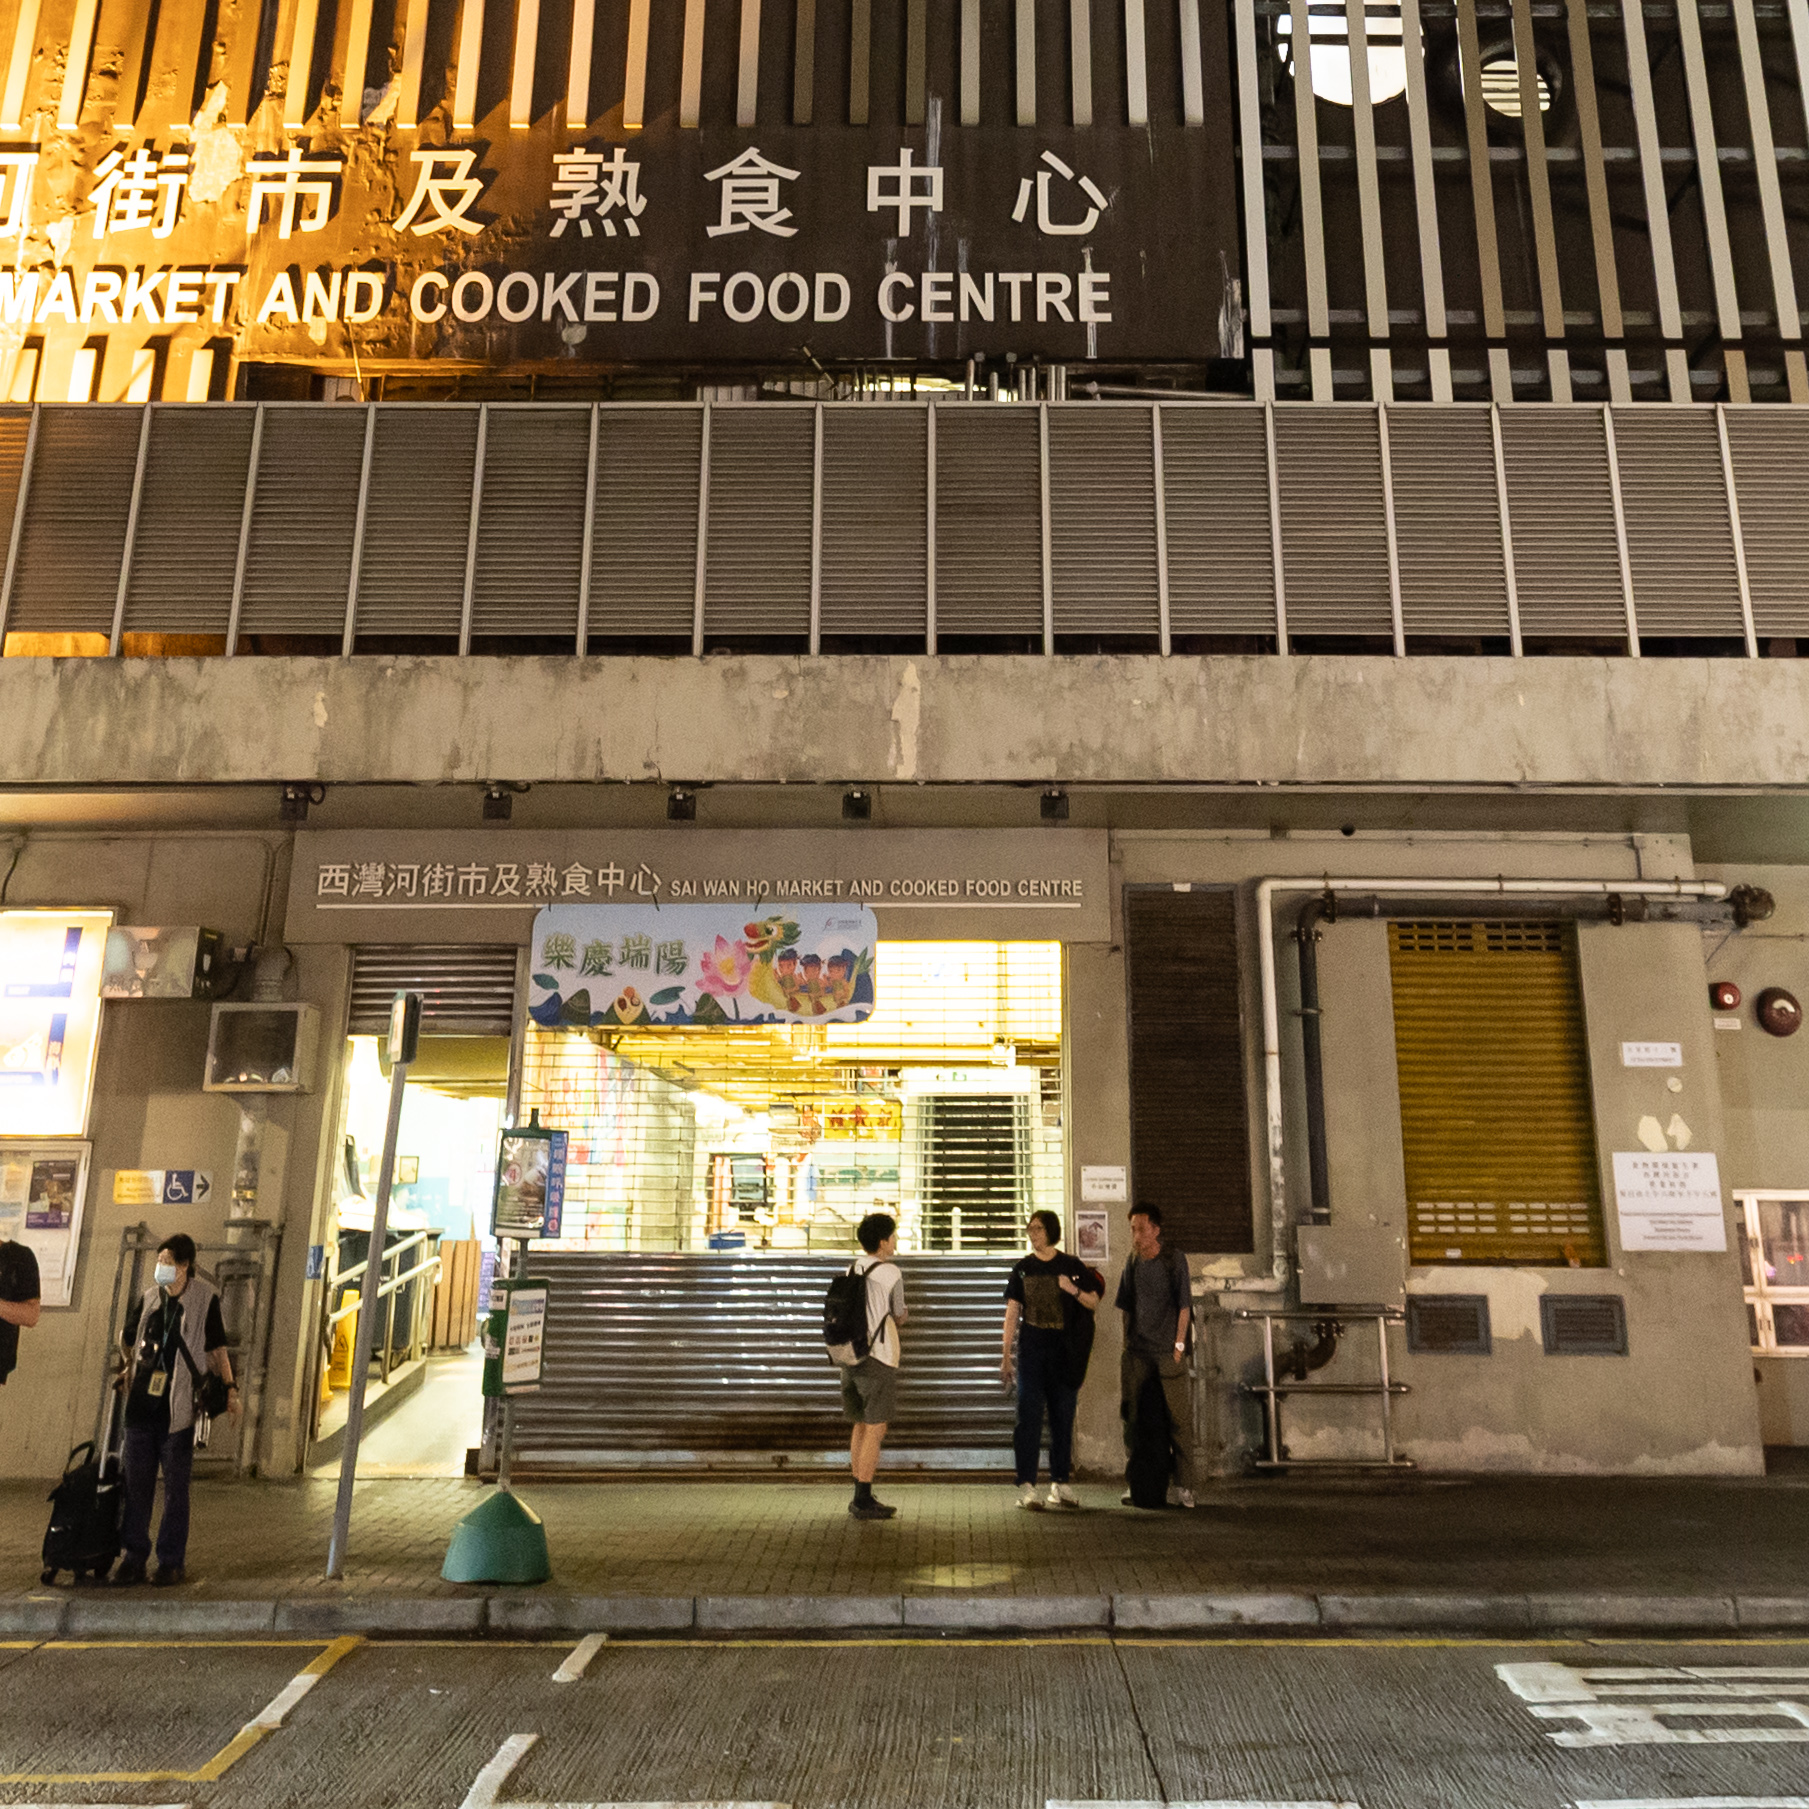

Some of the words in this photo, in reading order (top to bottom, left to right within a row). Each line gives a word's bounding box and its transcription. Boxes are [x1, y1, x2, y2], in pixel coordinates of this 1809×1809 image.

[257, 271, 384, 324] AND
[409, 271, 661, 323] COOKED
[688, 271, 852, 323] FOOD
[877, 271, 1113, 323] CENTRE
[317, 861, 662, 898] 西灣河街市及熟食中心
[670, 879, 698, 896] SAI
[703, 879, 741, 896] WAN
[746, 879, 771, 896] HO
[776, 879, 844, 896] MARKET
[850, 879, 884, 896] AND
[890, 879, 960, 897] COOKED
[966, 879, 1012, 897] FOOD
[1018, 879, 1083, 897] CENTRE
[542, 932, 690, 977] 樂慶端陽
